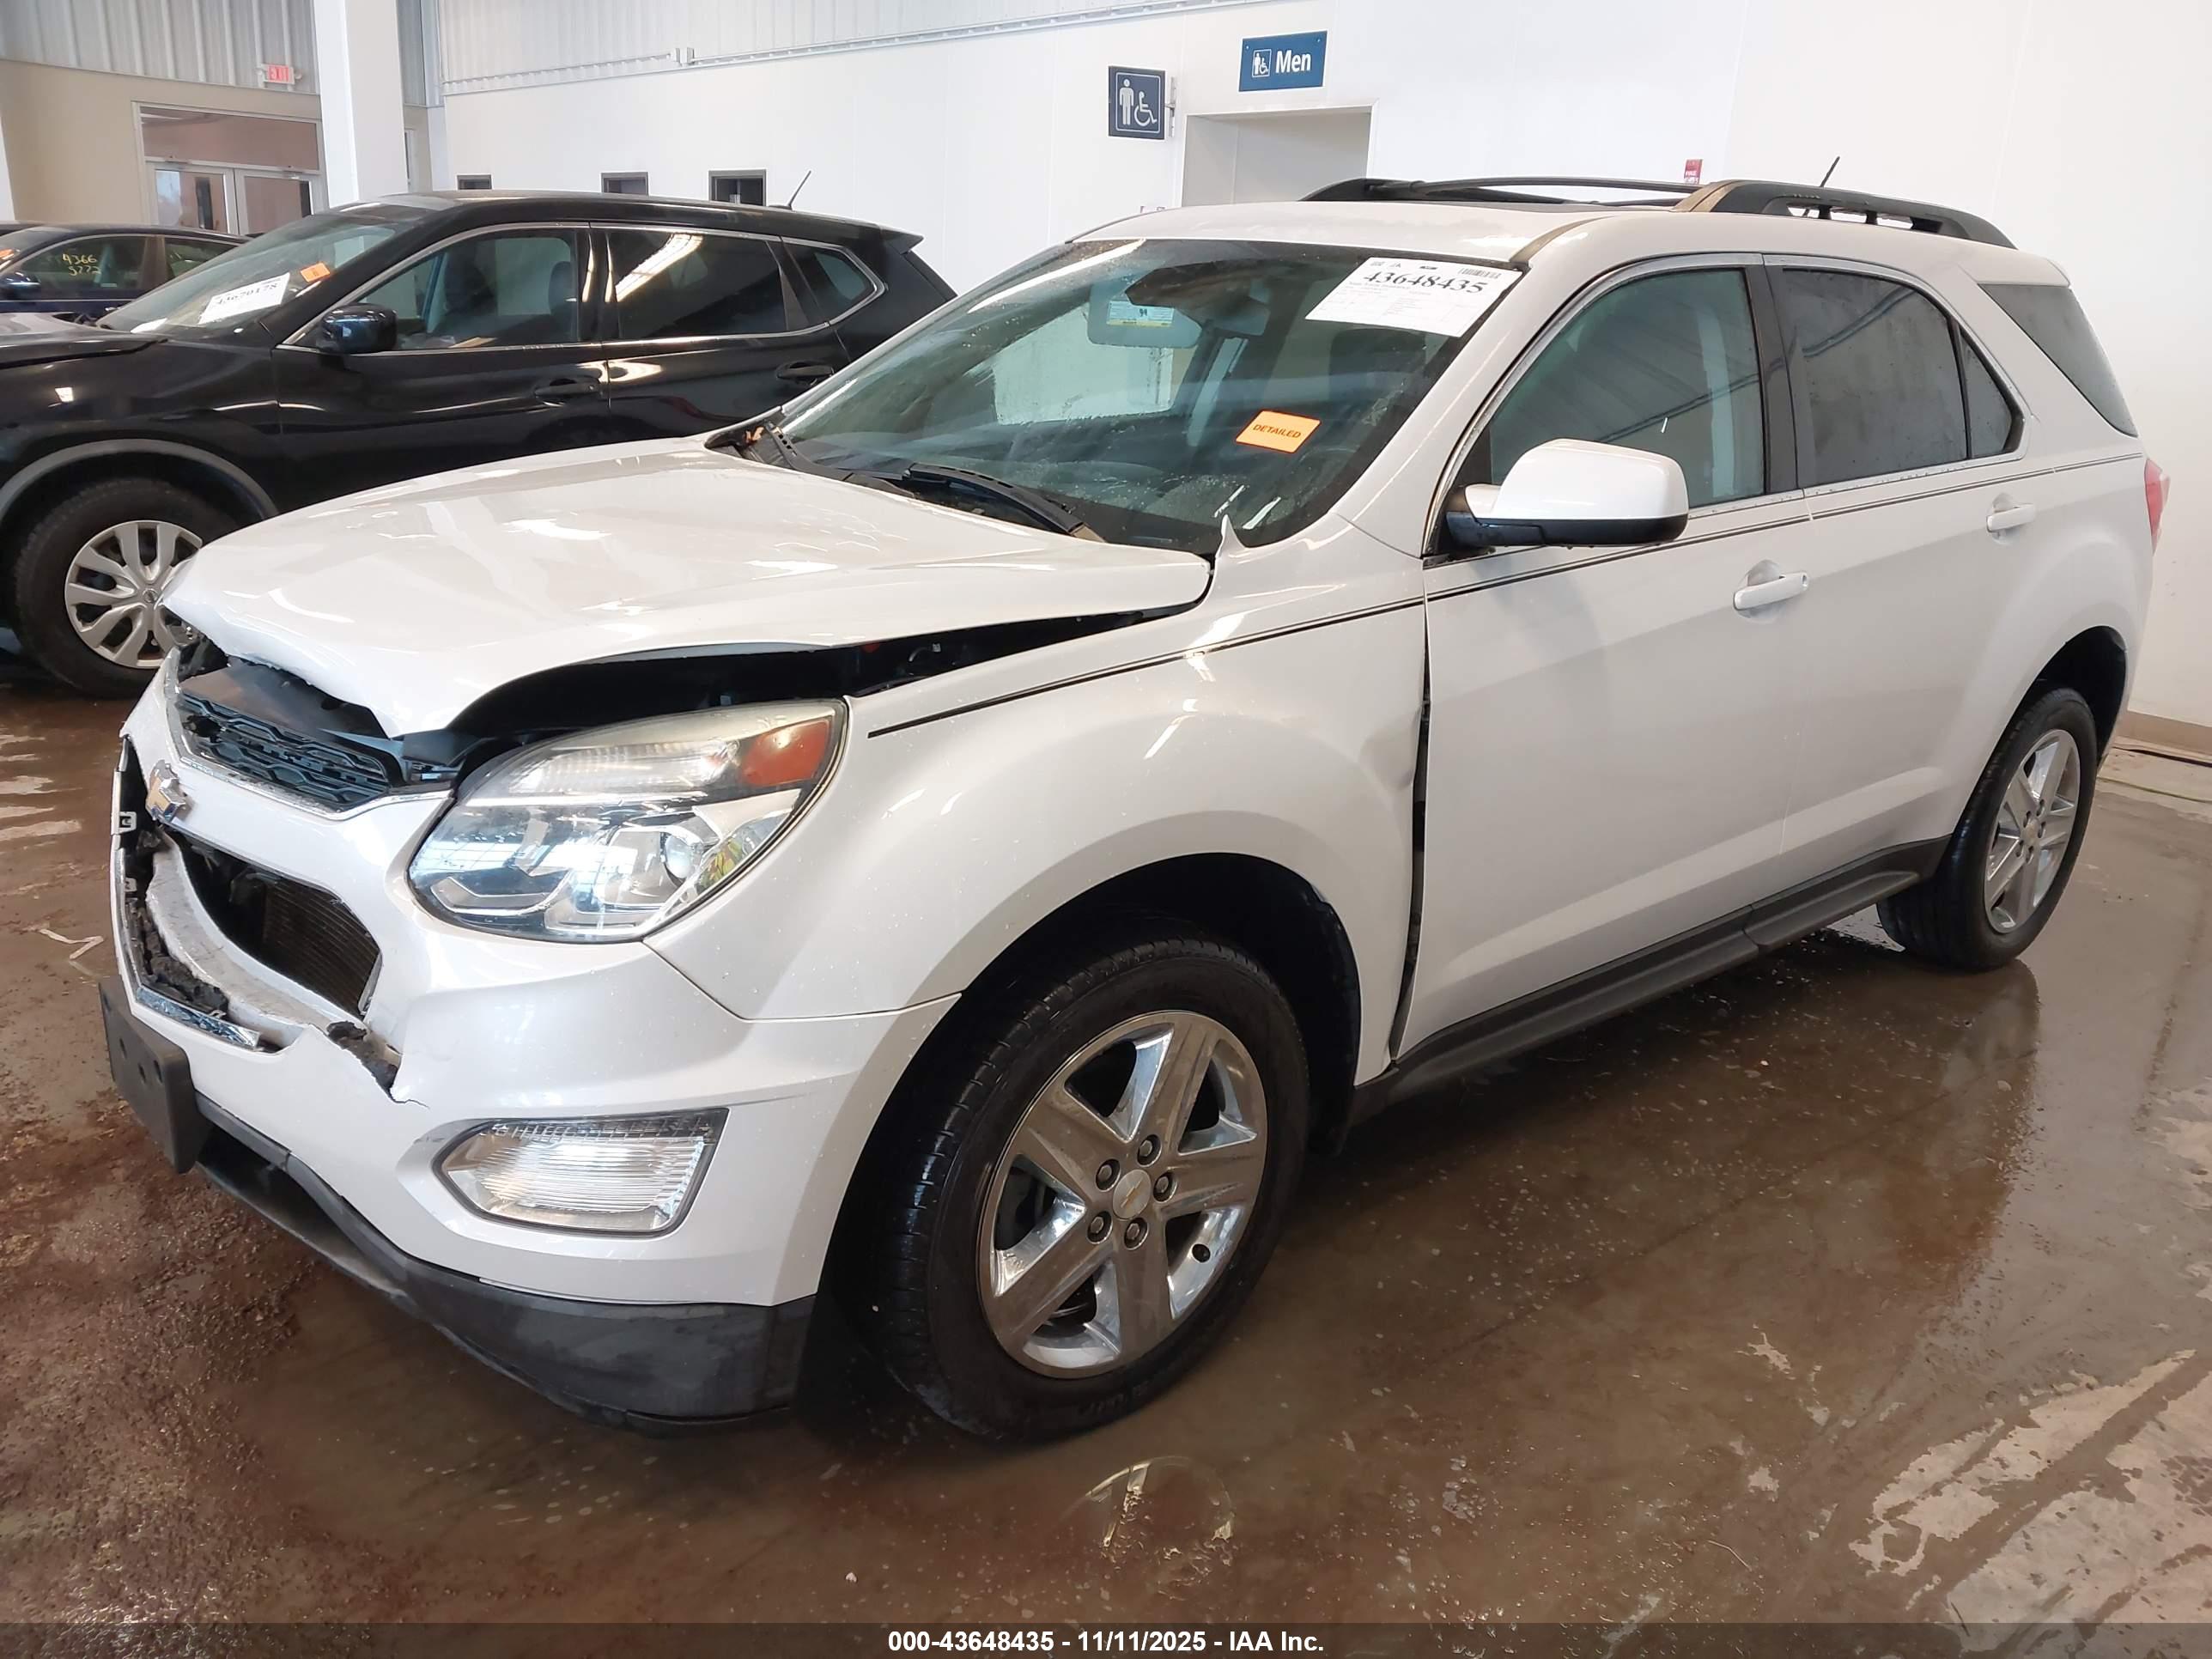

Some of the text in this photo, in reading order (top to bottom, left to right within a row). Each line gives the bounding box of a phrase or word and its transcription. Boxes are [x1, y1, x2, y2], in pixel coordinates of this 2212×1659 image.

[1275, 50, 1311, 73] Men
[1364, 271, 1488, 294] 43648435
[1253, 424, 1302, 439] DETAILED
